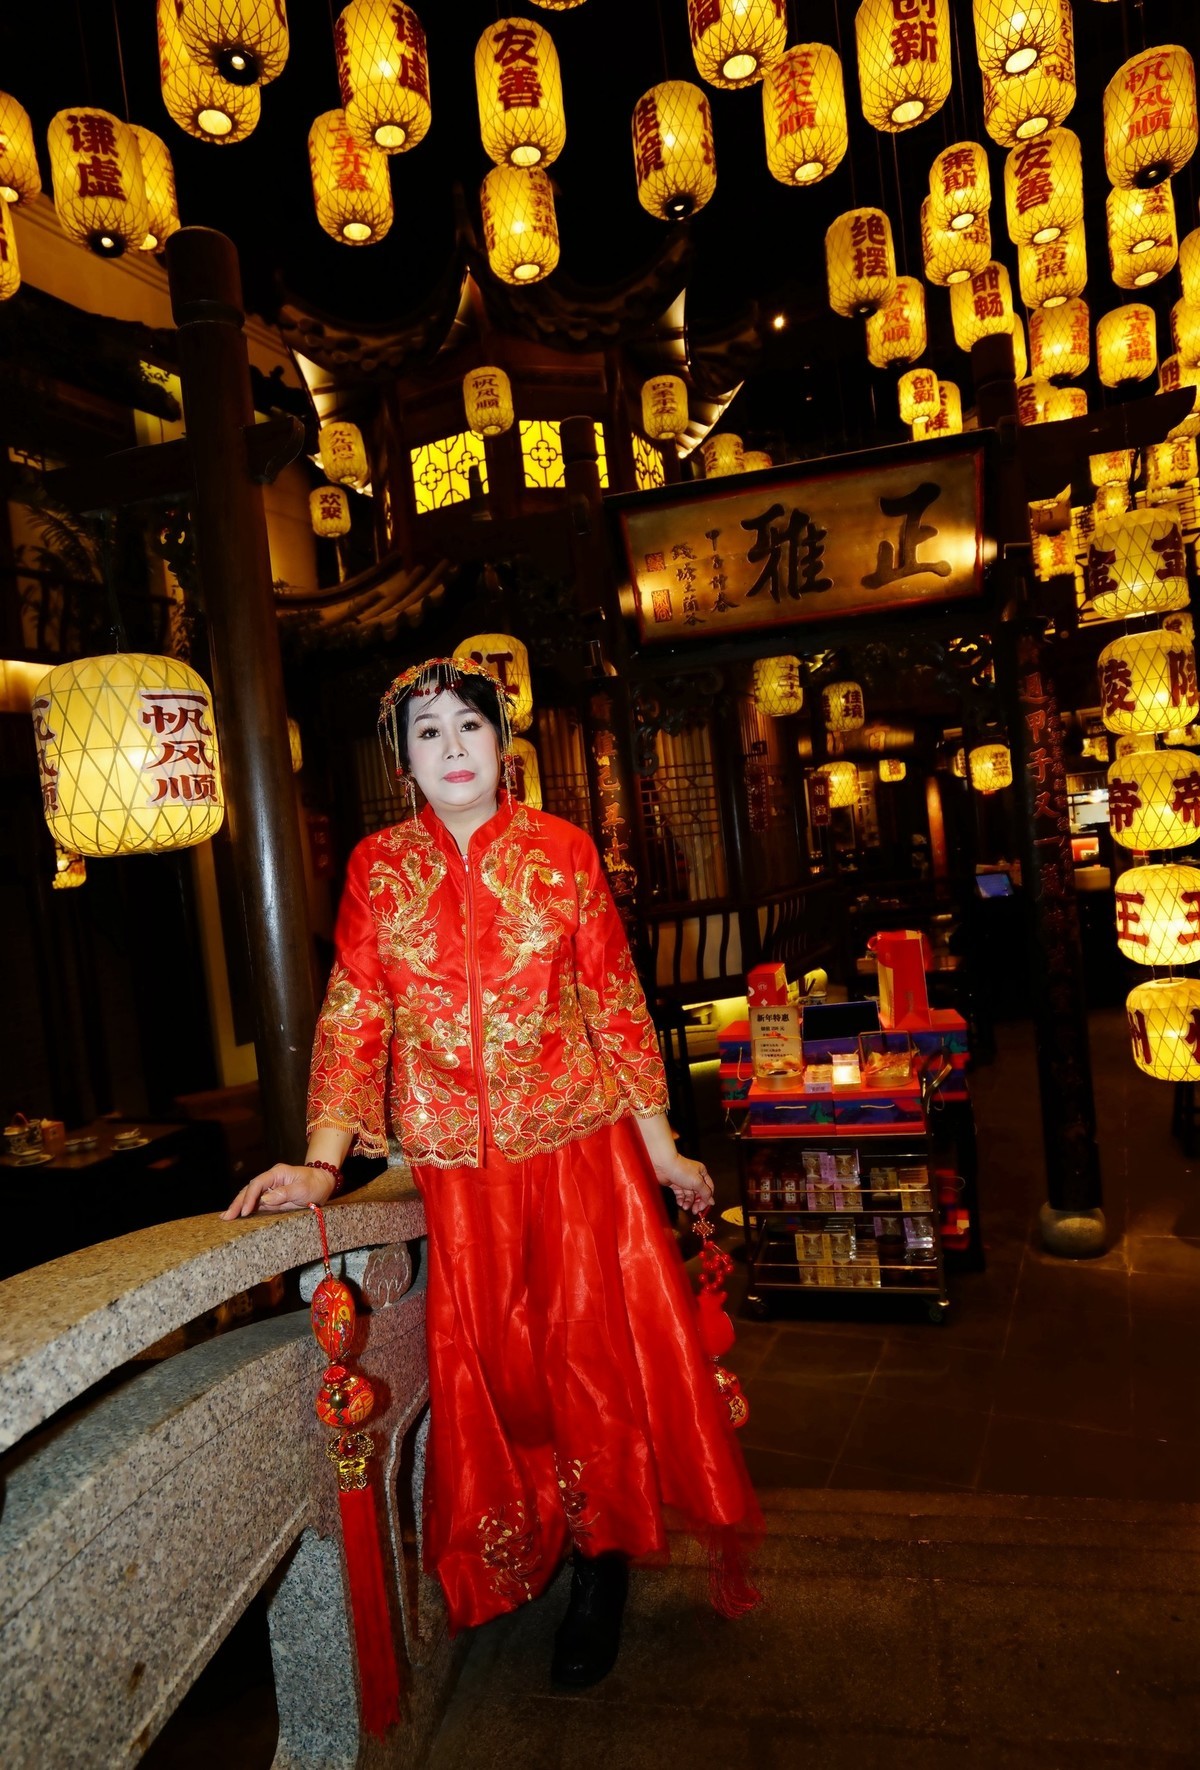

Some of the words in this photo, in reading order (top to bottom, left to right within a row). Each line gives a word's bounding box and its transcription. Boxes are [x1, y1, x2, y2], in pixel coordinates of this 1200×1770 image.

[494, 25, 543, 112] 友善
[1124, 52, 1173, 145] 一帆风顺
[67, 114, 127, 201] 谦虚
[1014, 139, 1053, 215] 友善
[851, 214, 888, 280] 绝摆
[972, 265, 1004, 321] 酣畅
[471, 373, 500, 410] 一帆风顺
[911, 376, 935, 405] 创新
[319, 493, 342, 520] 欢聚
[141, 693, 219, 803] 一帆风顺
[757, 1013, 789, 1022] 新年特惠
